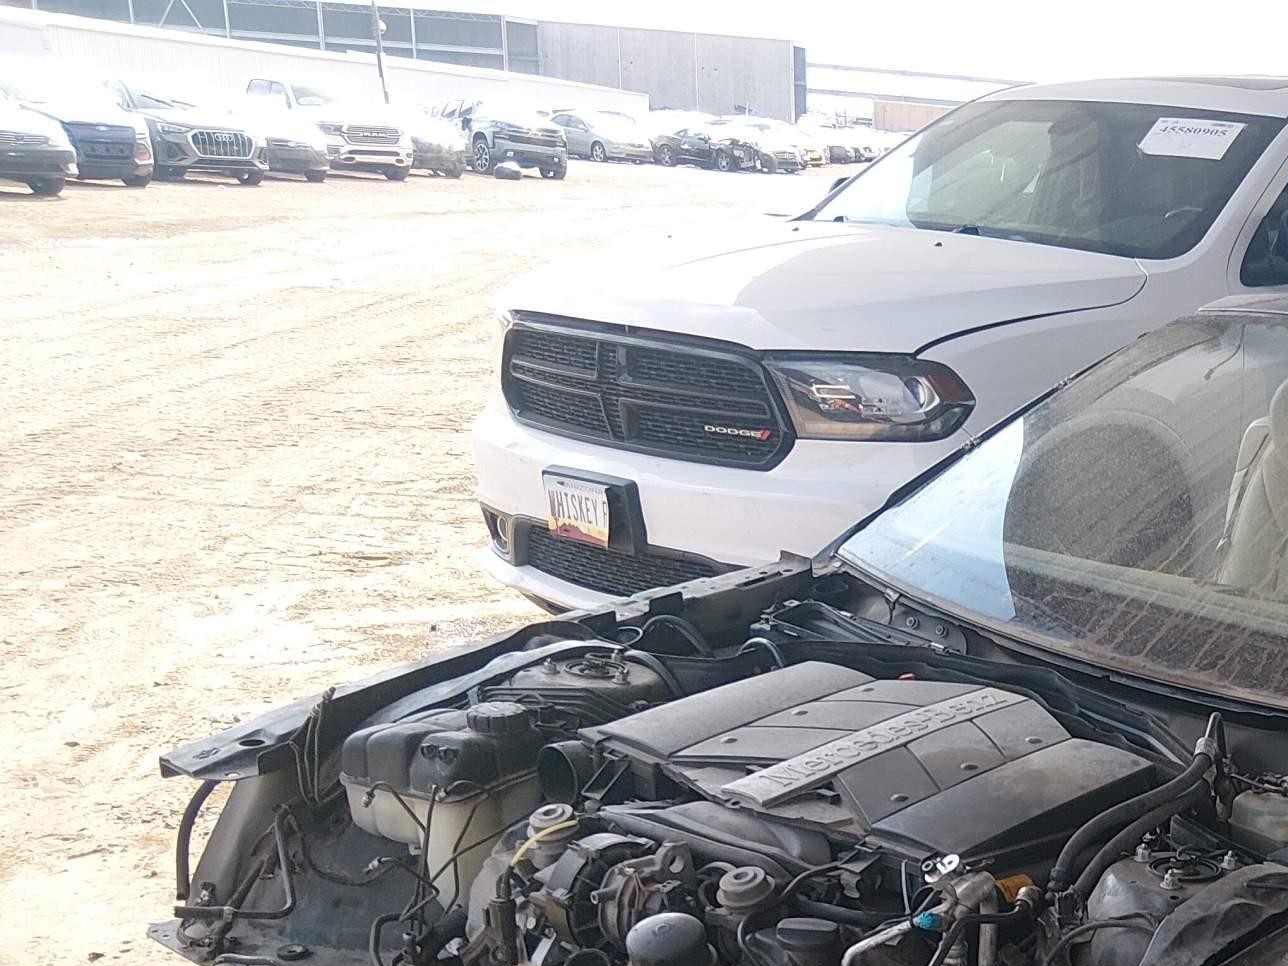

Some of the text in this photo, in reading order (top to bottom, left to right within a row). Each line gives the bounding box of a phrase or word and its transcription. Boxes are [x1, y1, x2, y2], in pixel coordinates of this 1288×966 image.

[703, 424, 762, 439] DODGE
[547, 488, 599, 527] WHISKEY
[758, 692, 1009, 788] Mercedes-Benz
